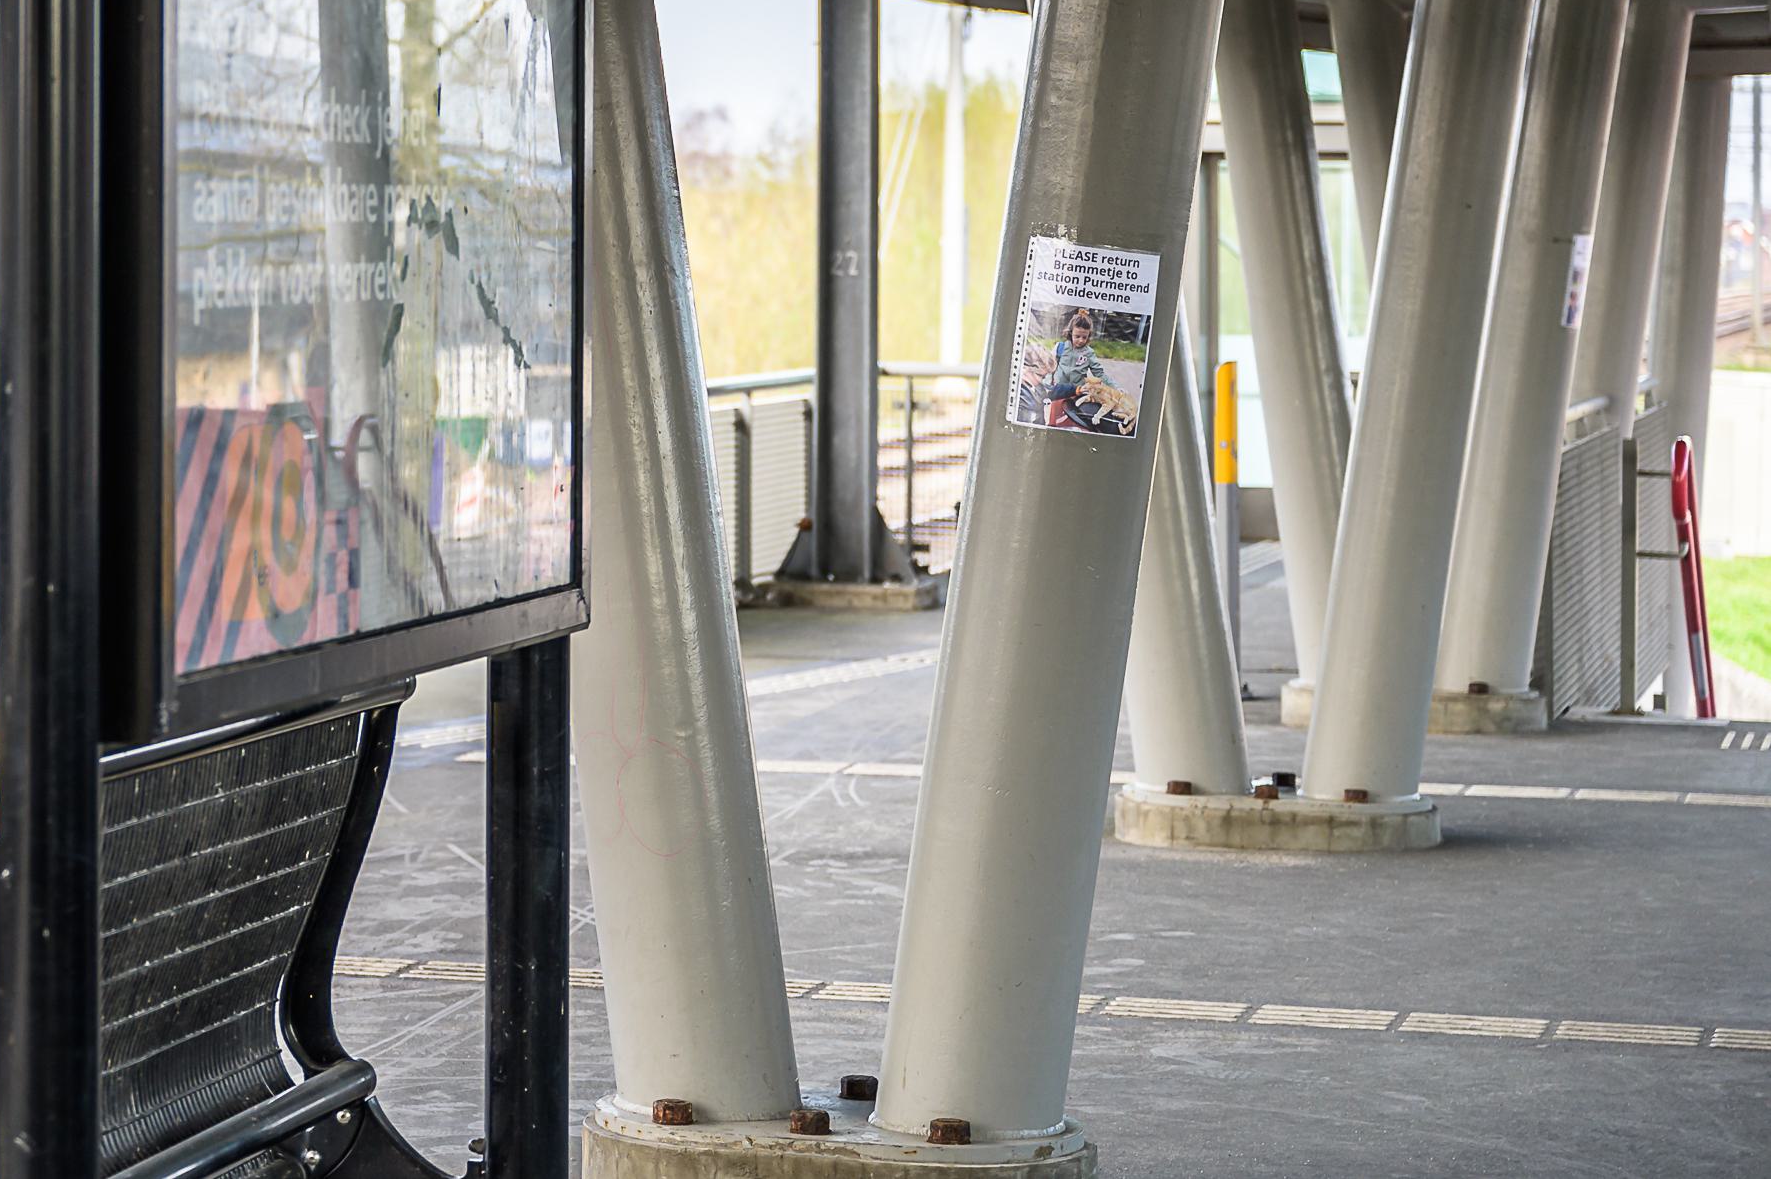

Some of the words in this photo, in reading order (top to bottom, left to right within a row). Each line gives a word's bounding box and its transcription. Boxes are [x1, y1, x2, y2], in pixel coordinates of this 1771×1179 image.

[1054, 248, 1099, 263] PLEASE
[1101, 254, 1140, 268] return
[1054, 260, 1123, 280] Brammetje
[1126, 269, 1138, 280] to
[1037, 270, 1079, 284] station
[1083, 276, 1150, 293] Purmerend
[1055, 284, 1131, 303] Weidevenne
